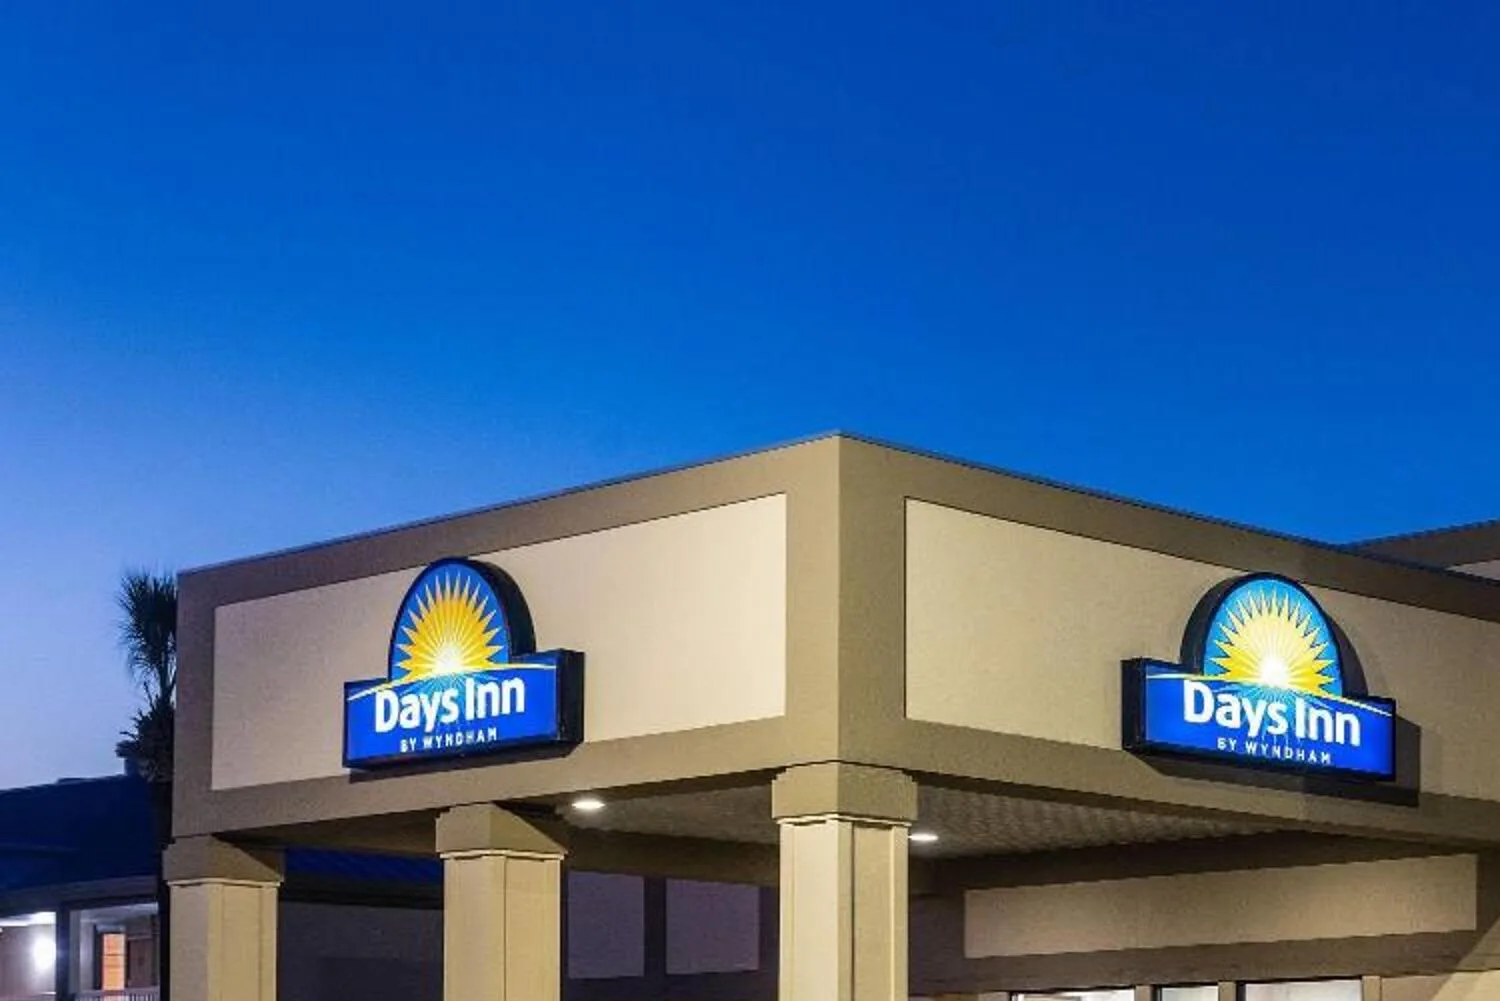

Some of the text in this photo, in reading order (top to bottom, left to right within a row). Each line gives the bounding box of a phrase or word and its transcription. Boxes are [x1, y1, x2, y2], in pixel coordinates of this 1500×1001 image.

[375, 677, 525, 732] Days Inn
[1183, 680, 1361, 746] Days Inn
[400, 727, 498, 753] BY WYNDHAM
[1217, 737, 1332, 765] BY WYNDHAM
